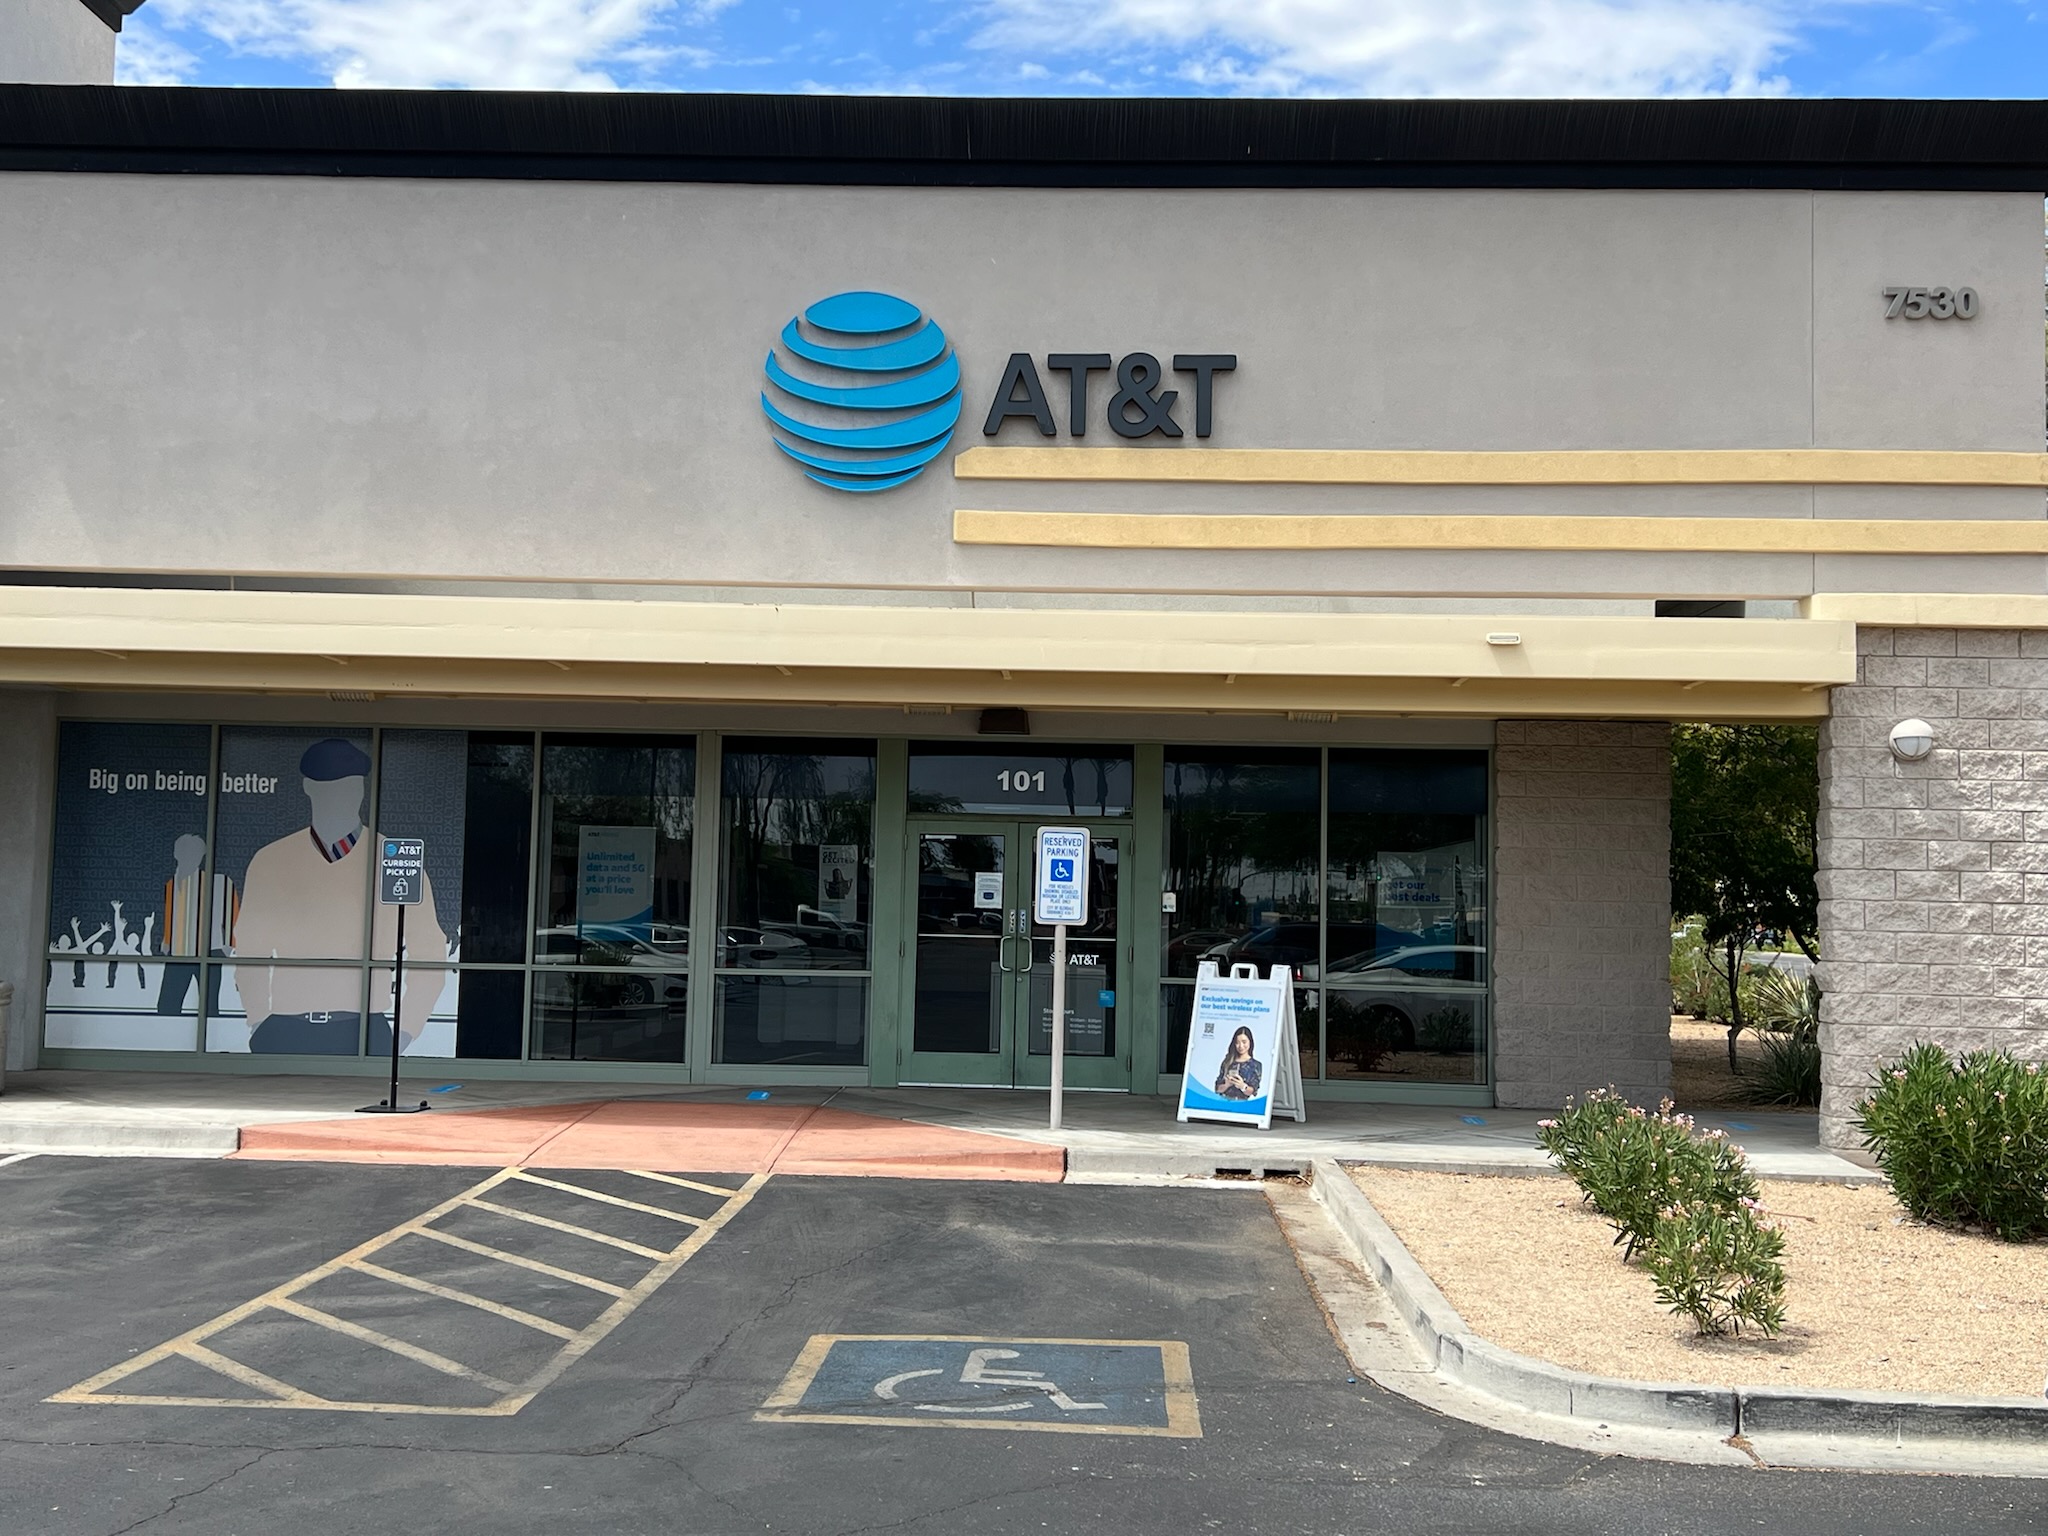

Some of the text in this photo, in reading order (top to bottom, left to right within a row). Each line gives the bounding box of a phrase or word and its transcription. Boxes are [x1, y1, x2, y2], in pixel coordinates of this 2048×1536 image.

[1882, 286, 1980, 320] 7530
[982, 351, 1238, 439] AT&T
[88, 768, 278, 796] Big on being better
[997, 769, 1045, 792] 101
[1044, 837, 1082, 847] RESERVED
[397, 845, 422, 855] AT&T
[1046, 847, 1079, 857] PARKING
[586, 852, 635, 861] Unlimited
[382, 859, 421, 867] CURBSIDE
[586, 862, 645, 872] data and 5G
[386, 868, 417, 876] PICK UP
[607, 875, 632, 884] price
[585, 885, 635, 895] you'll love
[1407, 882, 1426, 890] our
[1412, 892, 1441, 902] deals
[1069, 954, 1100, 966] AT&T
[1201, 995, 1230, 1003] Exclusive
[1231, 997, 1254, 1005] savings
[1227, 1004, 1252, 1012] wireless
